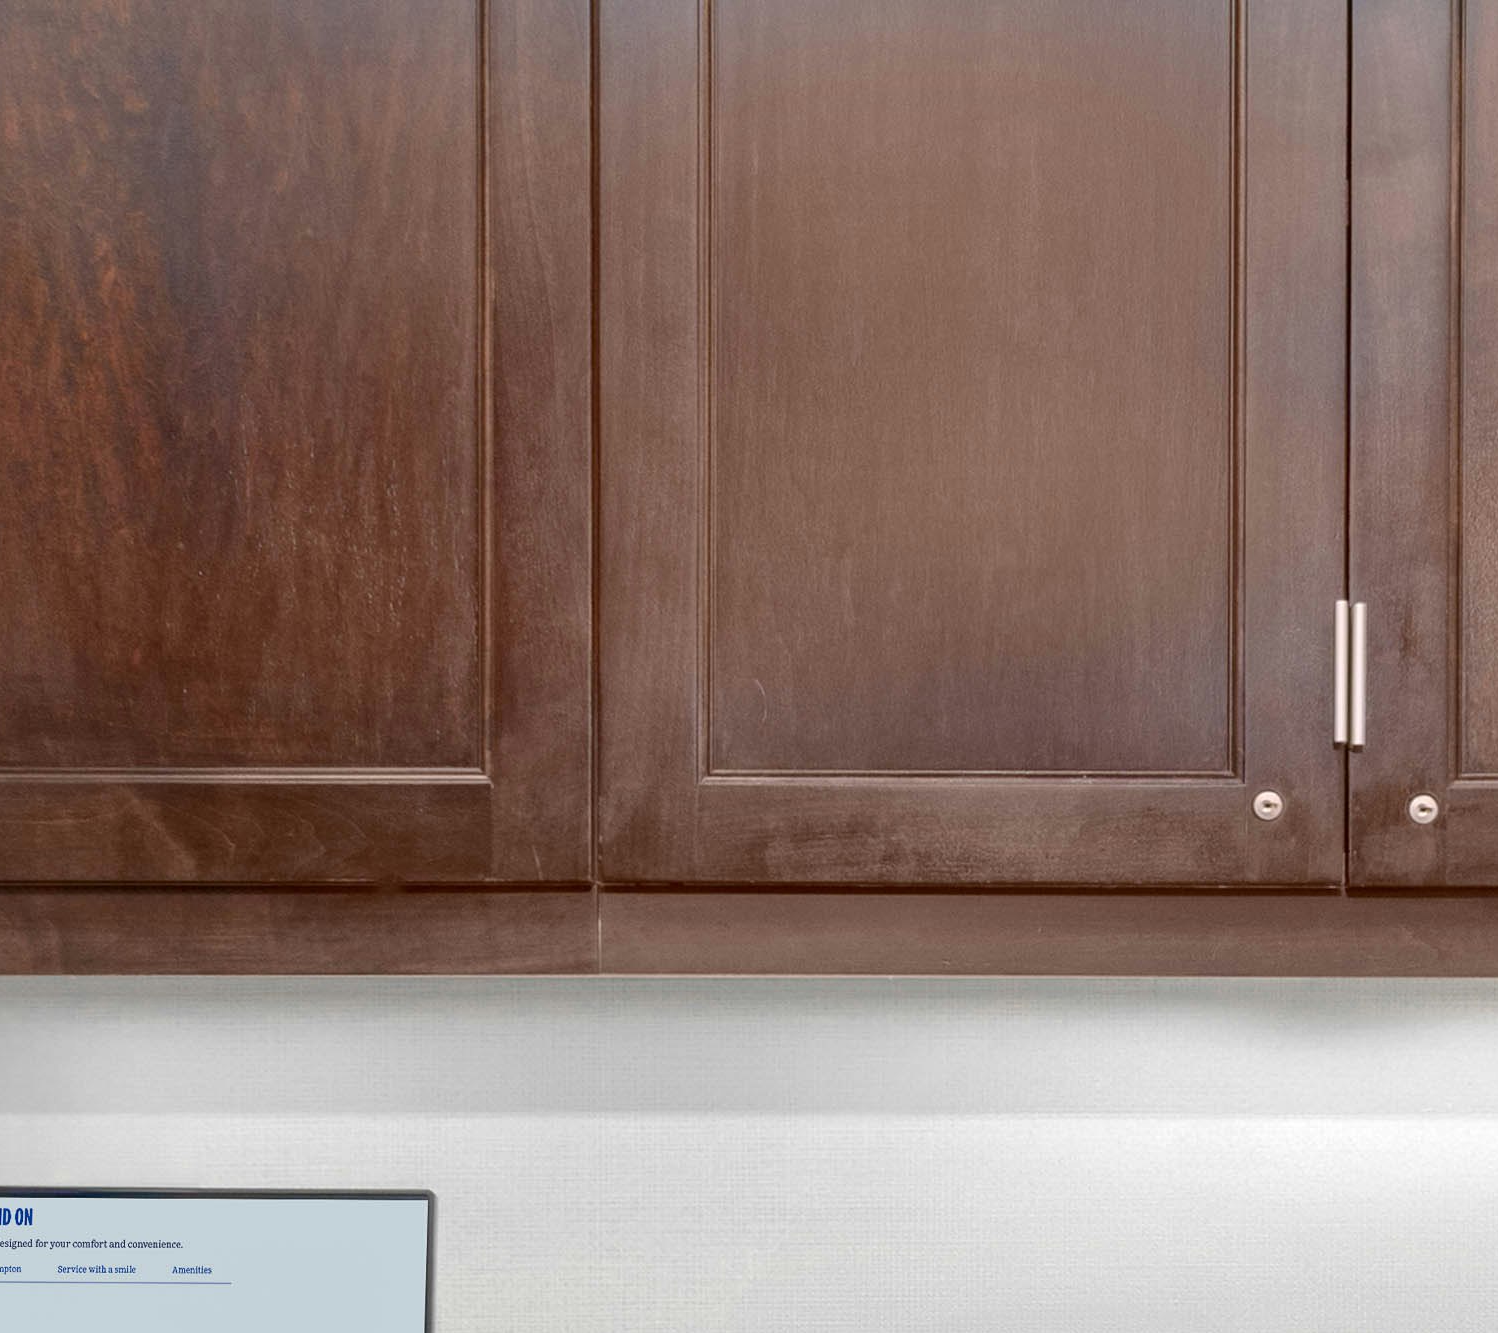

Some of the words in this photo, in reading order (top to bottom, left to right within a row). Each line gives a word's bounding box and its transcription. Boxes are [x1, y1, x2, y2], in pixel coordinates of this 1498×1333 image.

[15, 1208, 33, 1225] ON
[35, 1238, 49, 1248] for
[49, 1240, 72, 1250] your
[71, 1238, 108, 1249] comfort
[108, 1239, 127, 1249] and
[127, 1239, 184, 1249] convenience.
[57, 1264, 88, 1274] Service
[88, 1264, 107, 1274] with
[114, 1264, 137, 1274] smile
[171, 1265, 213, 1275] Amenities
